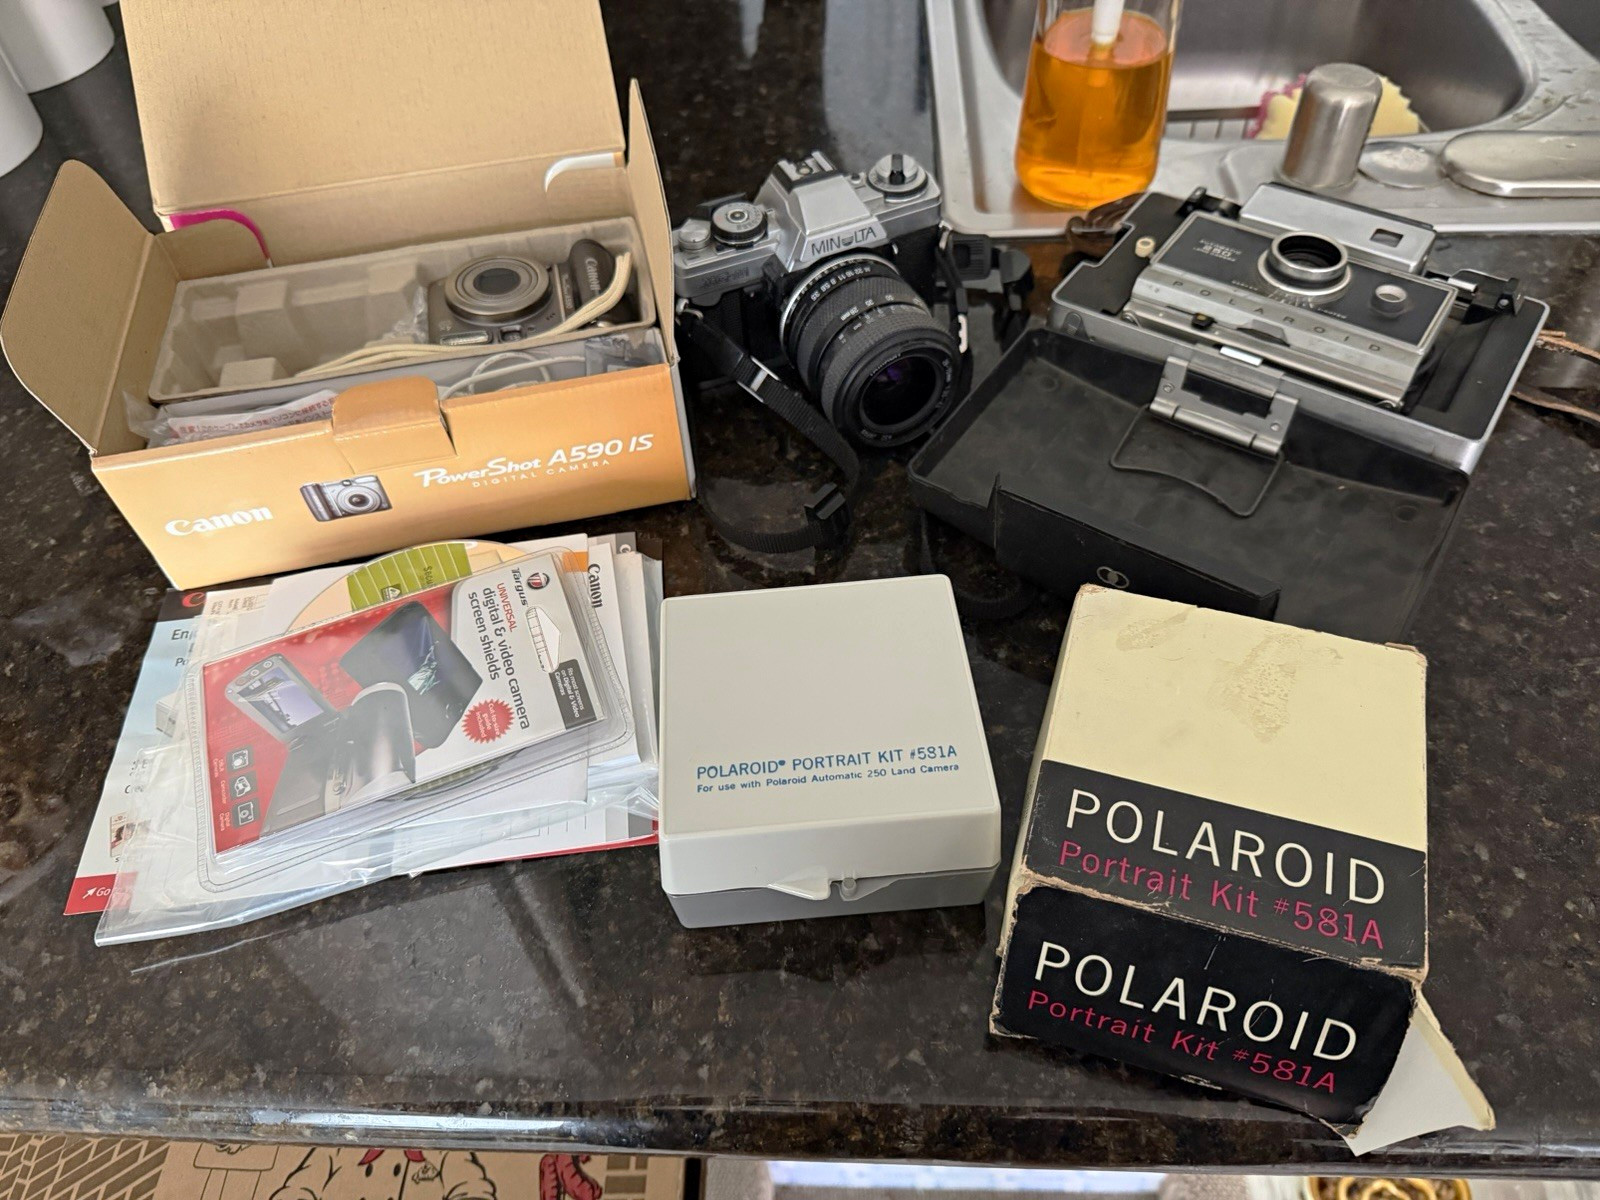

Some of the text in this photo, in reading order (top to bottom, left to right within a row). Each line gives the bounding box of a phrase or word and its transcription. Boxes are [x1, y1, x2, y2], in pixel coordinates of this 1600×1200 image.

[811, 227, 877, 256] MINOLTA
[1172, 281, 1381, 352] POLAROID
[413, 434, 654, 488] PowerShot A590 IS
[472, 459, 609, 488] DIGITAL CAMERA
[165, 506, 273, 537] Canon
[497, 582, 517, 632] UNIVERSAL
[512, 567, 527, 606] Targus
[588, 563, 603, 608] Canon
[468, 592, 500, 681] screen shields
[483, 587, 530, 730] digital & video camera
[554, 671, 565, 696] Cameras
[562, 676, 574, 696] Digital
[570, 700, 580, 718] Video
[570, 675, 579, 690] most
[697, 763, 959, 793] For use with Polaroid Automatic 250 Land Camera
[793, 752, 871, 771] PORTRAIT
[878, 749, 903, 763] KIT
[910, 745, 957, 760] #581A
[1066, 788, 1385, 905] POLAROID
[96, 887, 111, 897] Go
[1059, 840, 1385, 950] Portrait Kit #581A
[1034, 941, 1357, 1062] POLAROID
[1027, 989, 1337, 1094] Portrait Kit #581A
